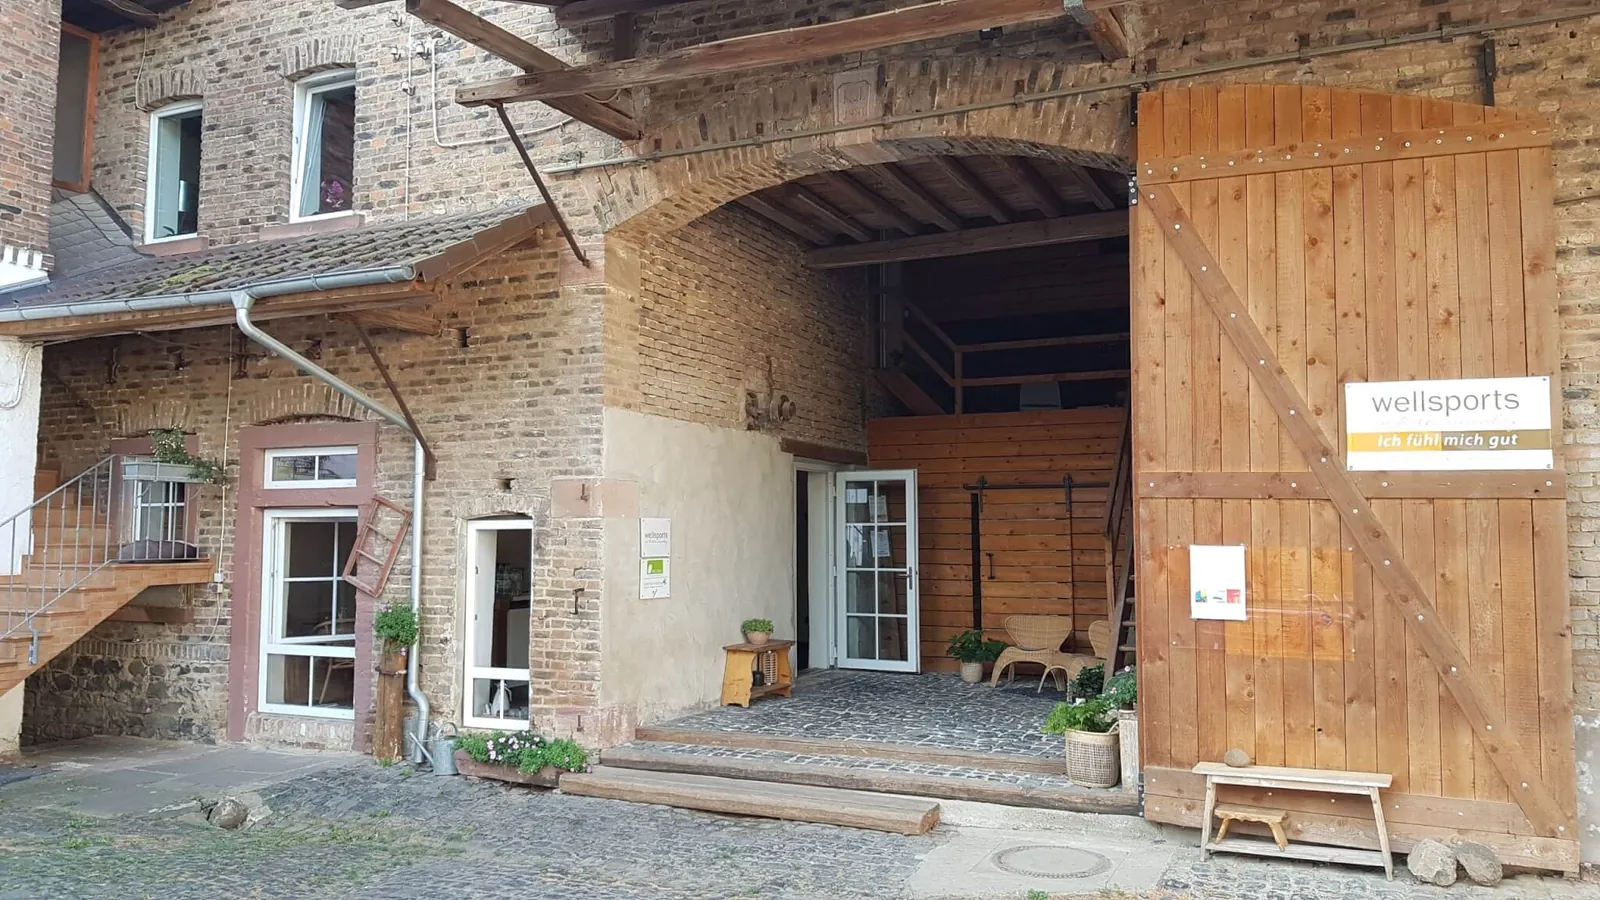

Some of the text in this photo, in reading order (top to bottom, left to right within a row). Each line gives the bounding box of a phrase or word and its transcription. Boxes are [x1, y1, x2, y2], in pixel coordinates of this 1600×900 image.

[1371, 389, 1520, 417] wellsports
[1377, 432, 1519, 449] Ich fühl mich gut
[645, 531, 668, 540] wellsports
